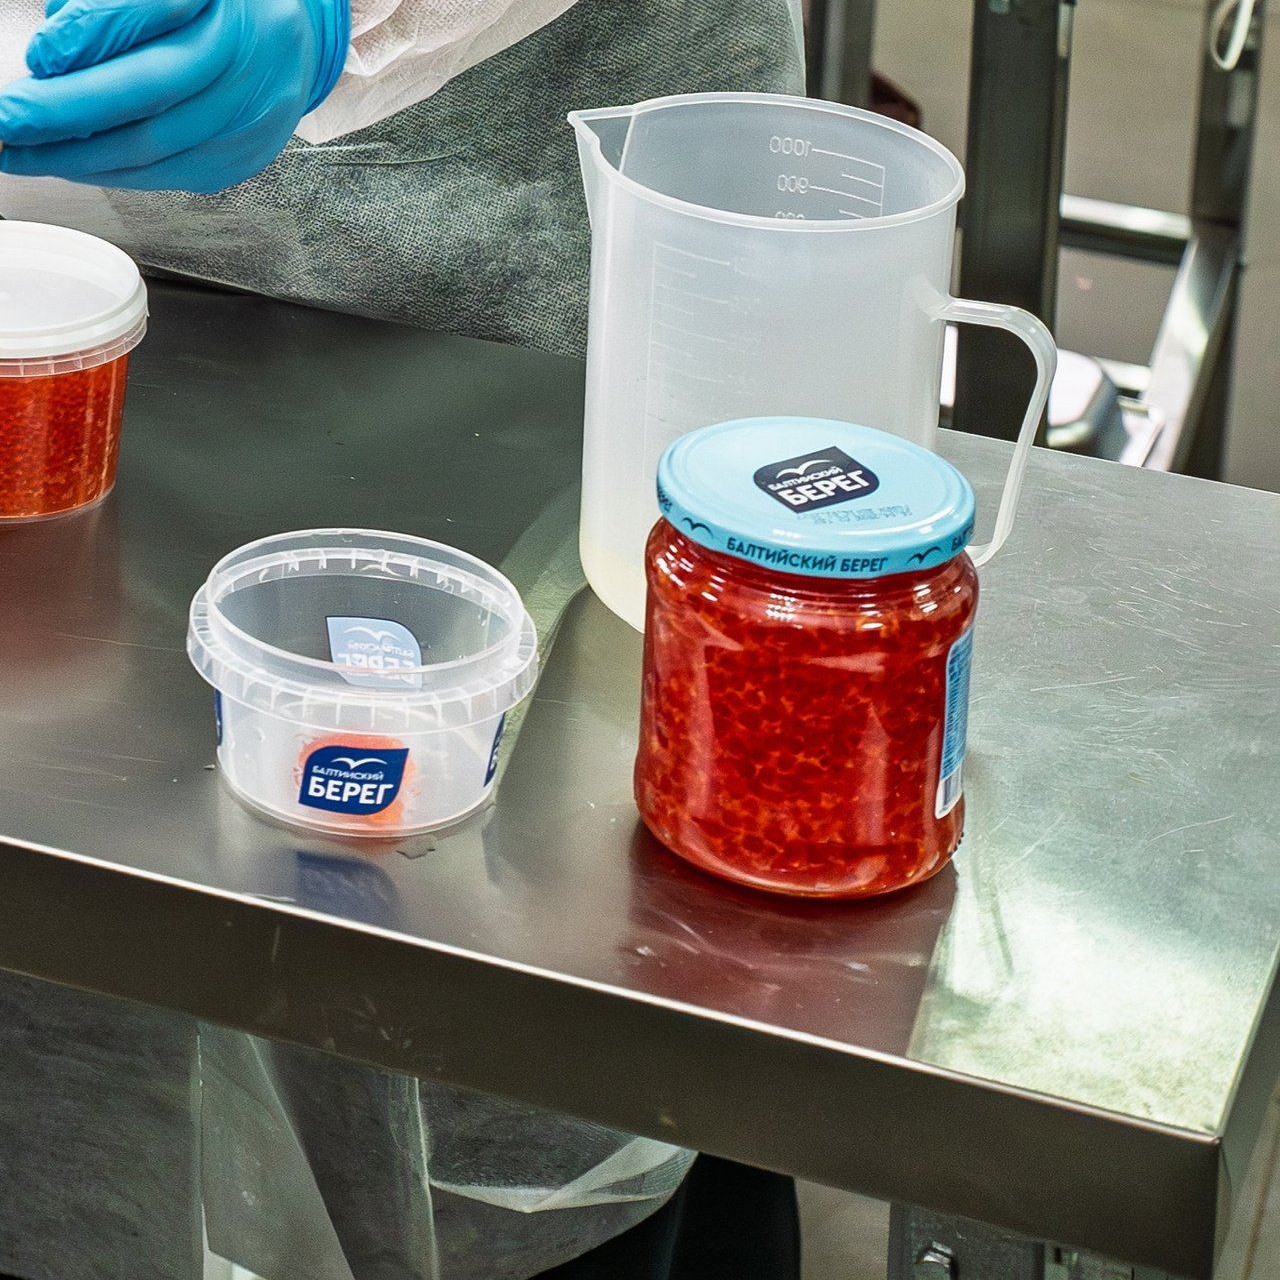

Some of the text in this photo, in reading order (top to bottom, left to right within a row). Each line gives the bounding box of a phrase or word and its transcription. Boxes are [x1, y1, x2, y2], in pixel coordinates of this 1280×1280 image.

[777, 469, 870, 507] БЕРЕГ
[726, 536, 889, 573] БАЛТИЙСКИЙ БЕРЕГ
[308, 776, 395, 805] БЕРЕГ
